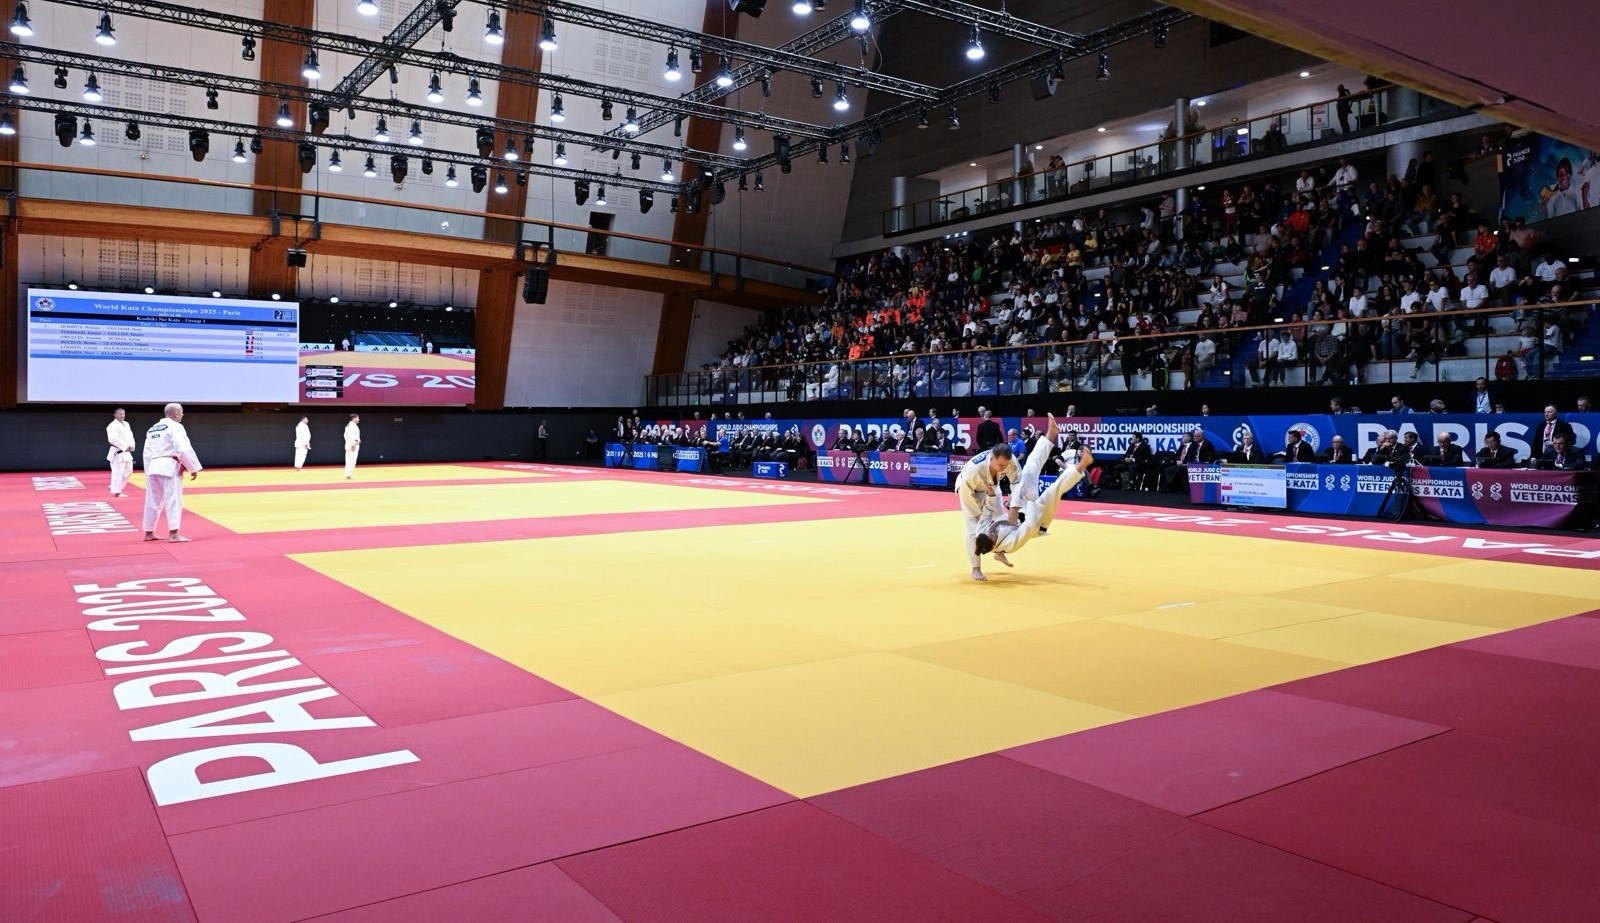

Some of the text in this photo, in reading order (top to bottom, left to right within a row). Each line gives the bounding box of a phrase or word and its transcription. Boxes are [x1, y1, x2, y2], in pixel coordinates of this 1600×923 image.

[1512, 147, 1531, 157] FRANCE
[1513, 155, 1526, 164] JUDO
[141, 305, 198, 315] Championships
[743, 424, 778, 432] CHAMPIONSHIPS
[1058, 423, 1202, 433] WORLD JUDO CHAMPIONSHIPS
[1357, 422, 1531, 463] PARIS
[869, 461, 889, 470] 2025
[1293, 480, 1317, 489] KATA
[1423, 486, 1430, 495] &
[1433, 487, 1462, 497] KATA
[1513, 491, 1580, 503] VETERANS
[1070, 509, 1269, 527] 2025
[73, 577, 247, 632] 2025
[95, 631, 421, 806] PARIS
